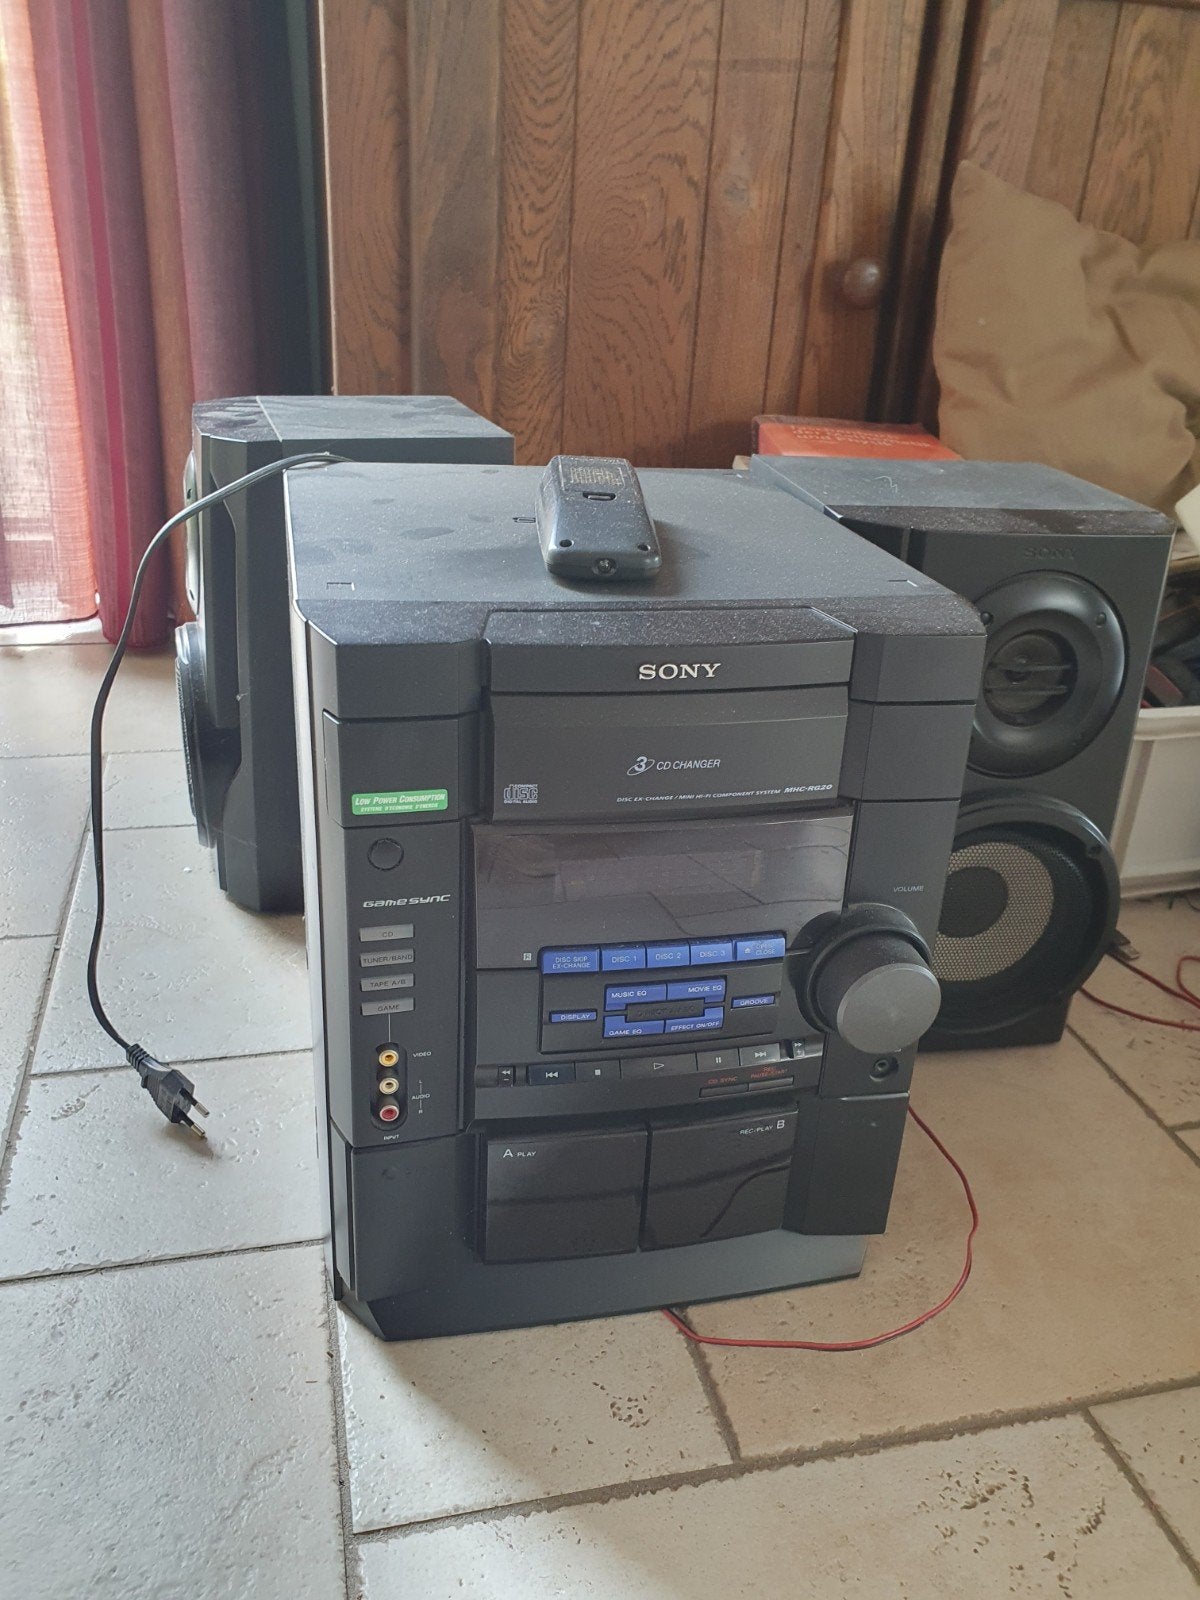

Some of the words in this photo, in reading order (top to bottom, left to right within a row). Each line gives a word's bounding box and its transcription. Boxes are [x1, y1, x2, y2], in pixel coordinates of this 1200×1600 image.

[639, 663, 721, 680] SONY
[635, 756, 648, 772] 3
[656, 761, 671, 771] CD
[672, 759, 721, 770] CHANGER
[712, 790, 755, 798] COMPONENT
[783, 784, 833, 794] MHC-RG20
[893, 885, 924, 893] VOLUME
[655, 953, 674, 961] DISC
[755, 948, 776, 956] CLOSE
[363, 954, 413, 964] TUNER/BAND
[611, 956, 630, 964] DISC
[560, 1013, 590, 1021] DISPLAY
[670, 1024, 695, 1032] EFFECT
[695, 1020, 720, 1029] ON/OFF
[776, 1119, 785, 1129] B
[502, 1148, 514, 1158] A
